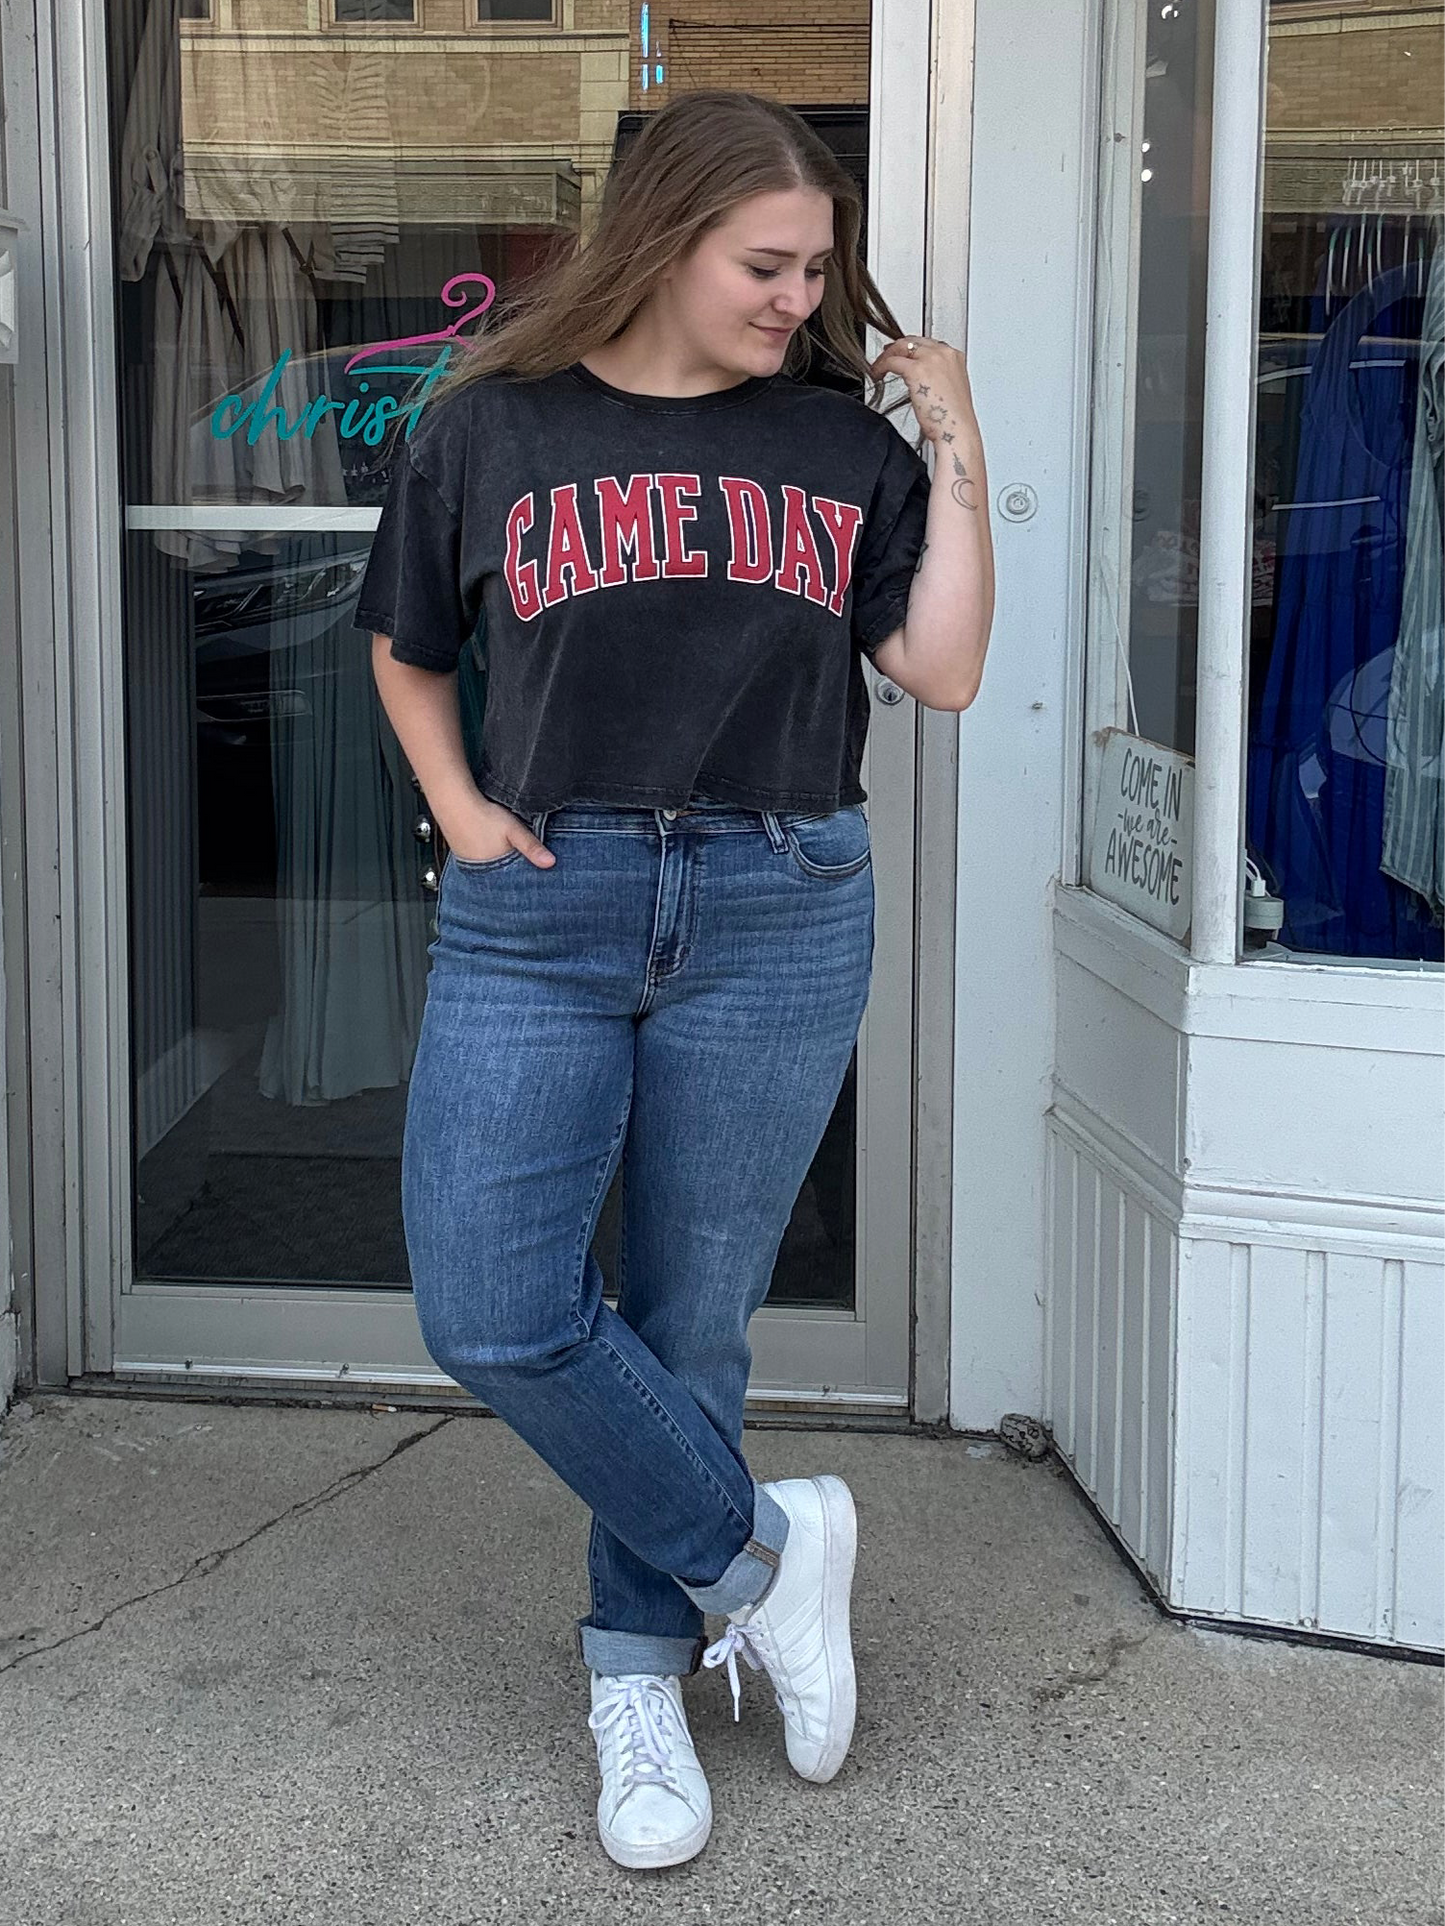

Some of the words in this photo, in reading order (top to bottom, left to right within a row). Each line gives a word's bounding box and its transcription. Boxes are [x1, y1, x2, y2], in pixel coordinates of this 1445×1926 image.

[504, 473, 708, 621] GAME
[719, 476, 864, 617] DAY
[1121, 747, 1162, 809] COME
[1163, 765, 1183, 822] IN
[1104, 827, 1183, 906] AWESOME
